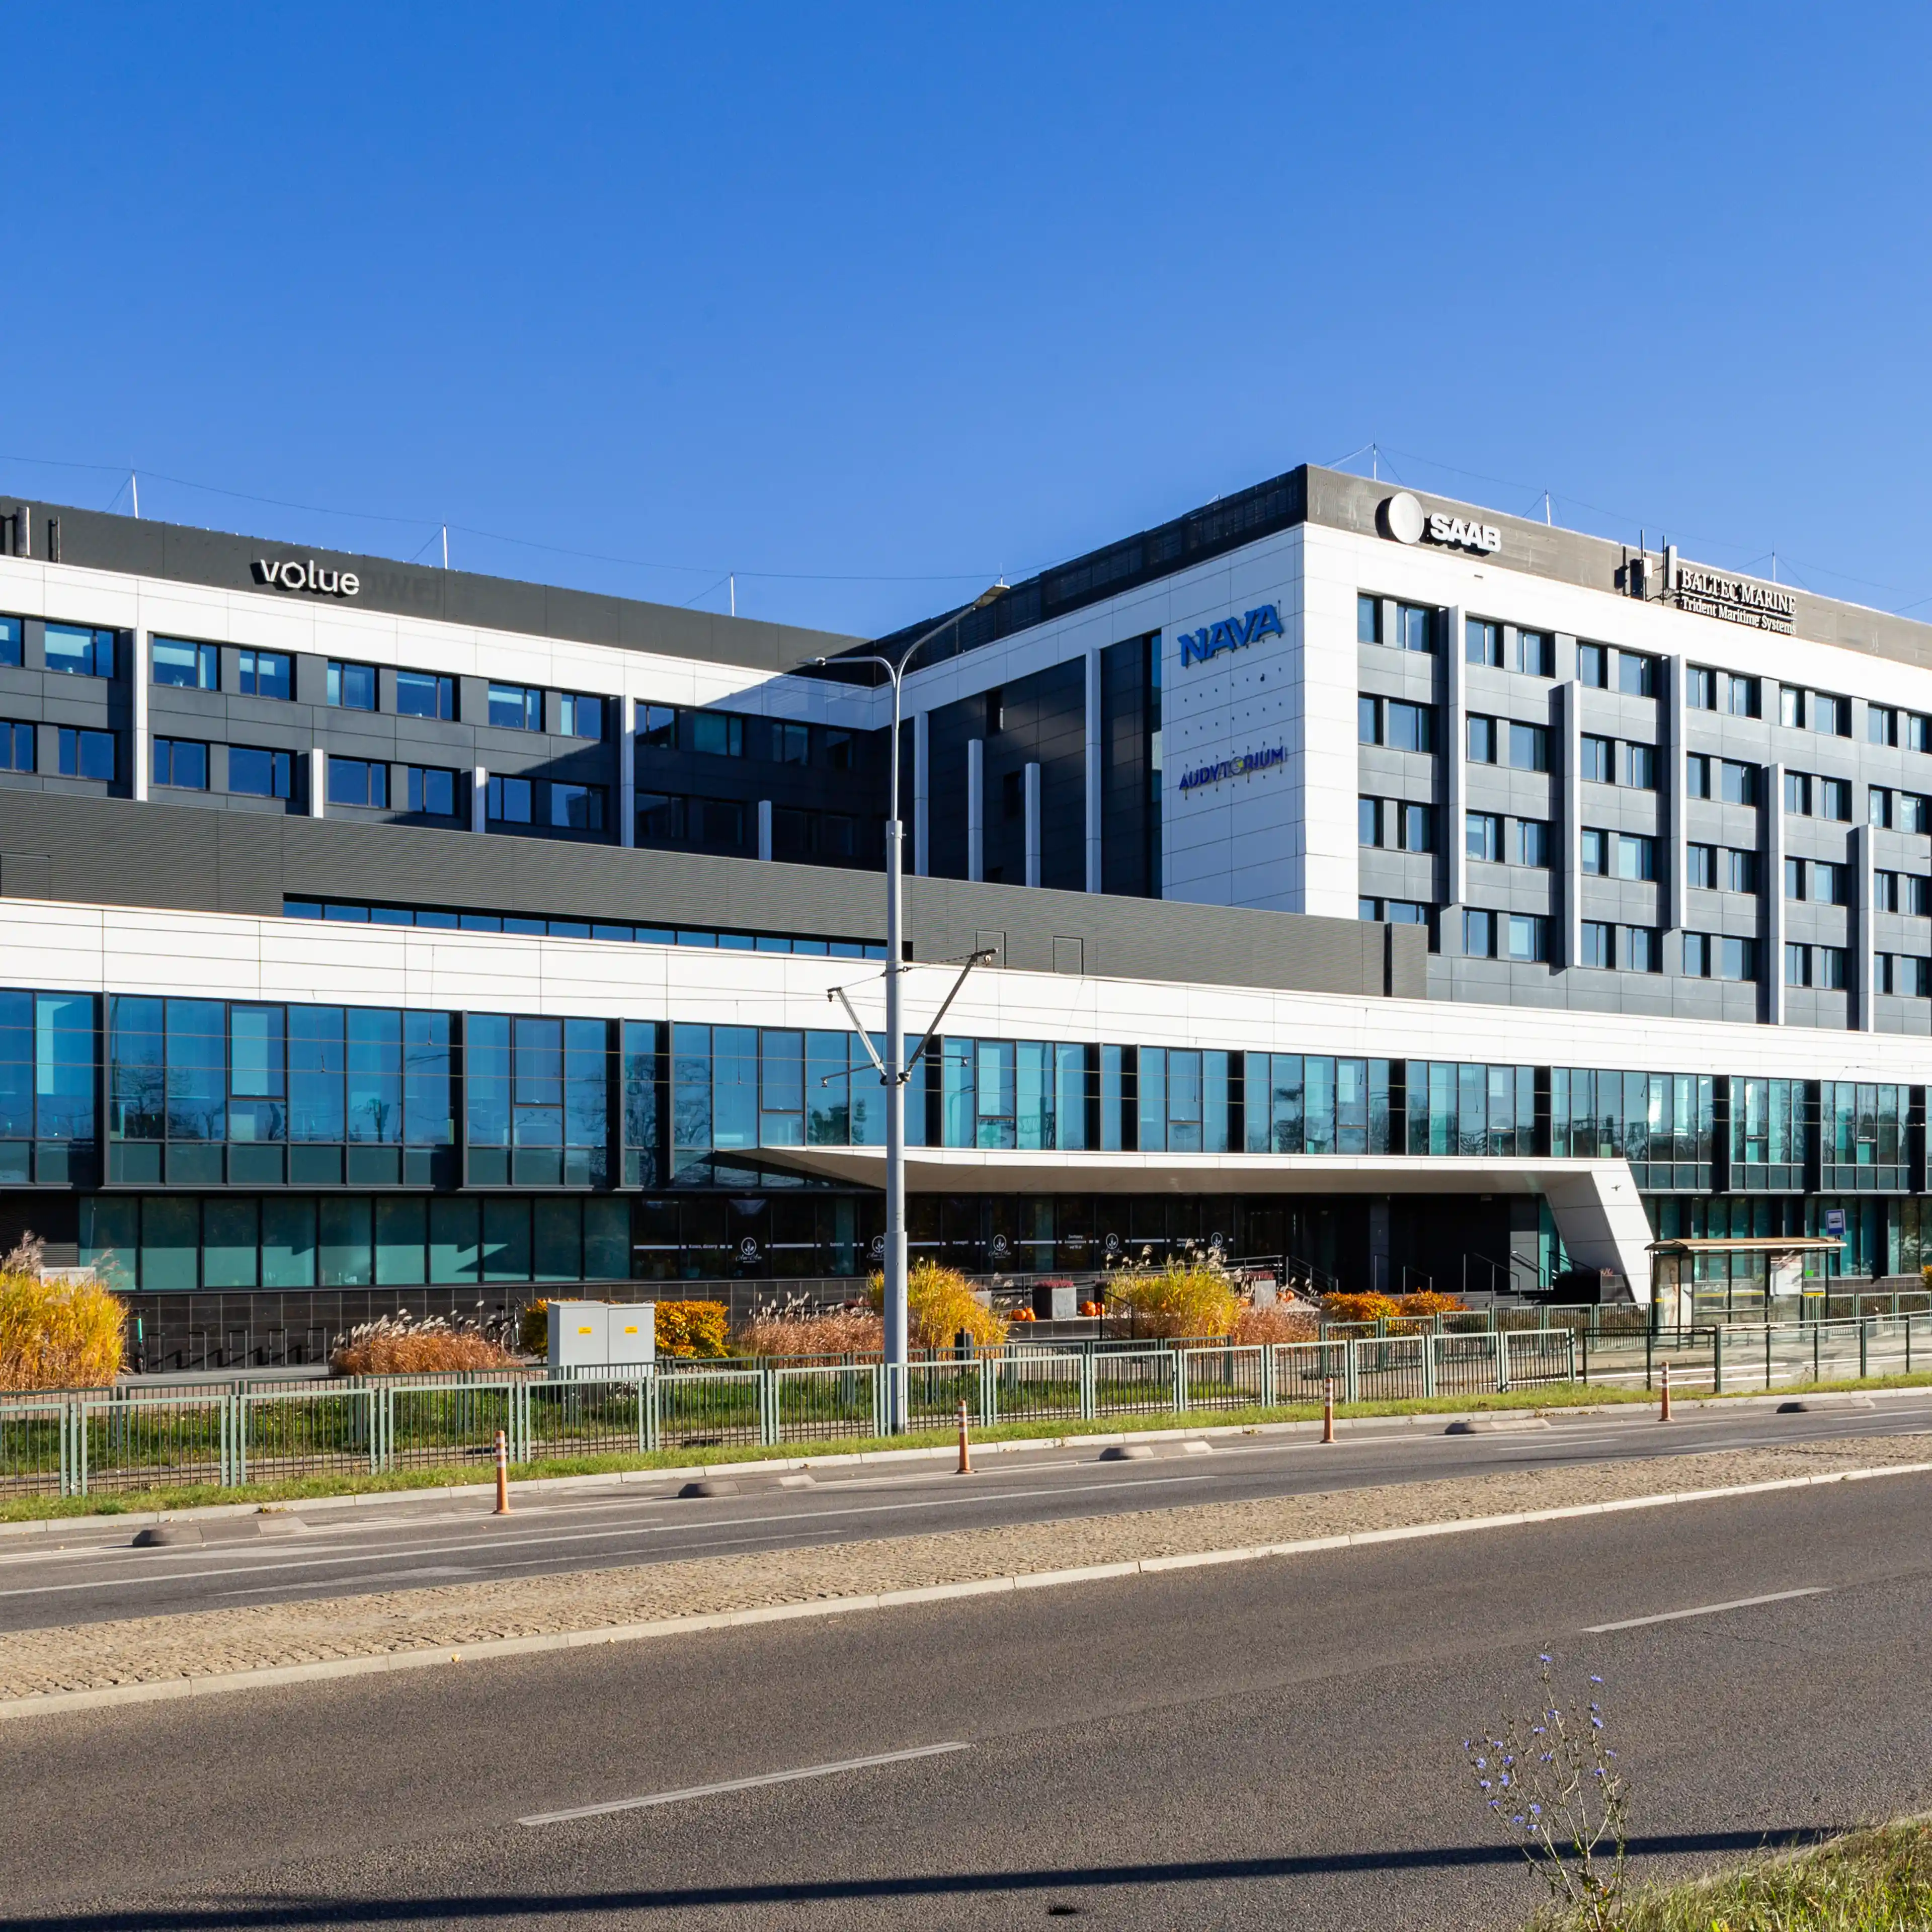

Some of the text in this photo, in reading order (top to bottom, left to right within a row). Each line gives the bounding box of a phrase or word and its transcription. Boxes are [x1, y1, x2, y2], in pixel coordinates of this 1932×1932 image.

[1430, 513, 1501, 552] SAAB
[260, 559, 360, 595] volue
[1682, 568, 1797, 614] BALTEC MARINE
[1177, 604, 1284, 667] NAVA
[1681, 596, 1797, 635] Trident Maritime Systems
[1179, 746, 1287, 791] AUDYTORIUM
